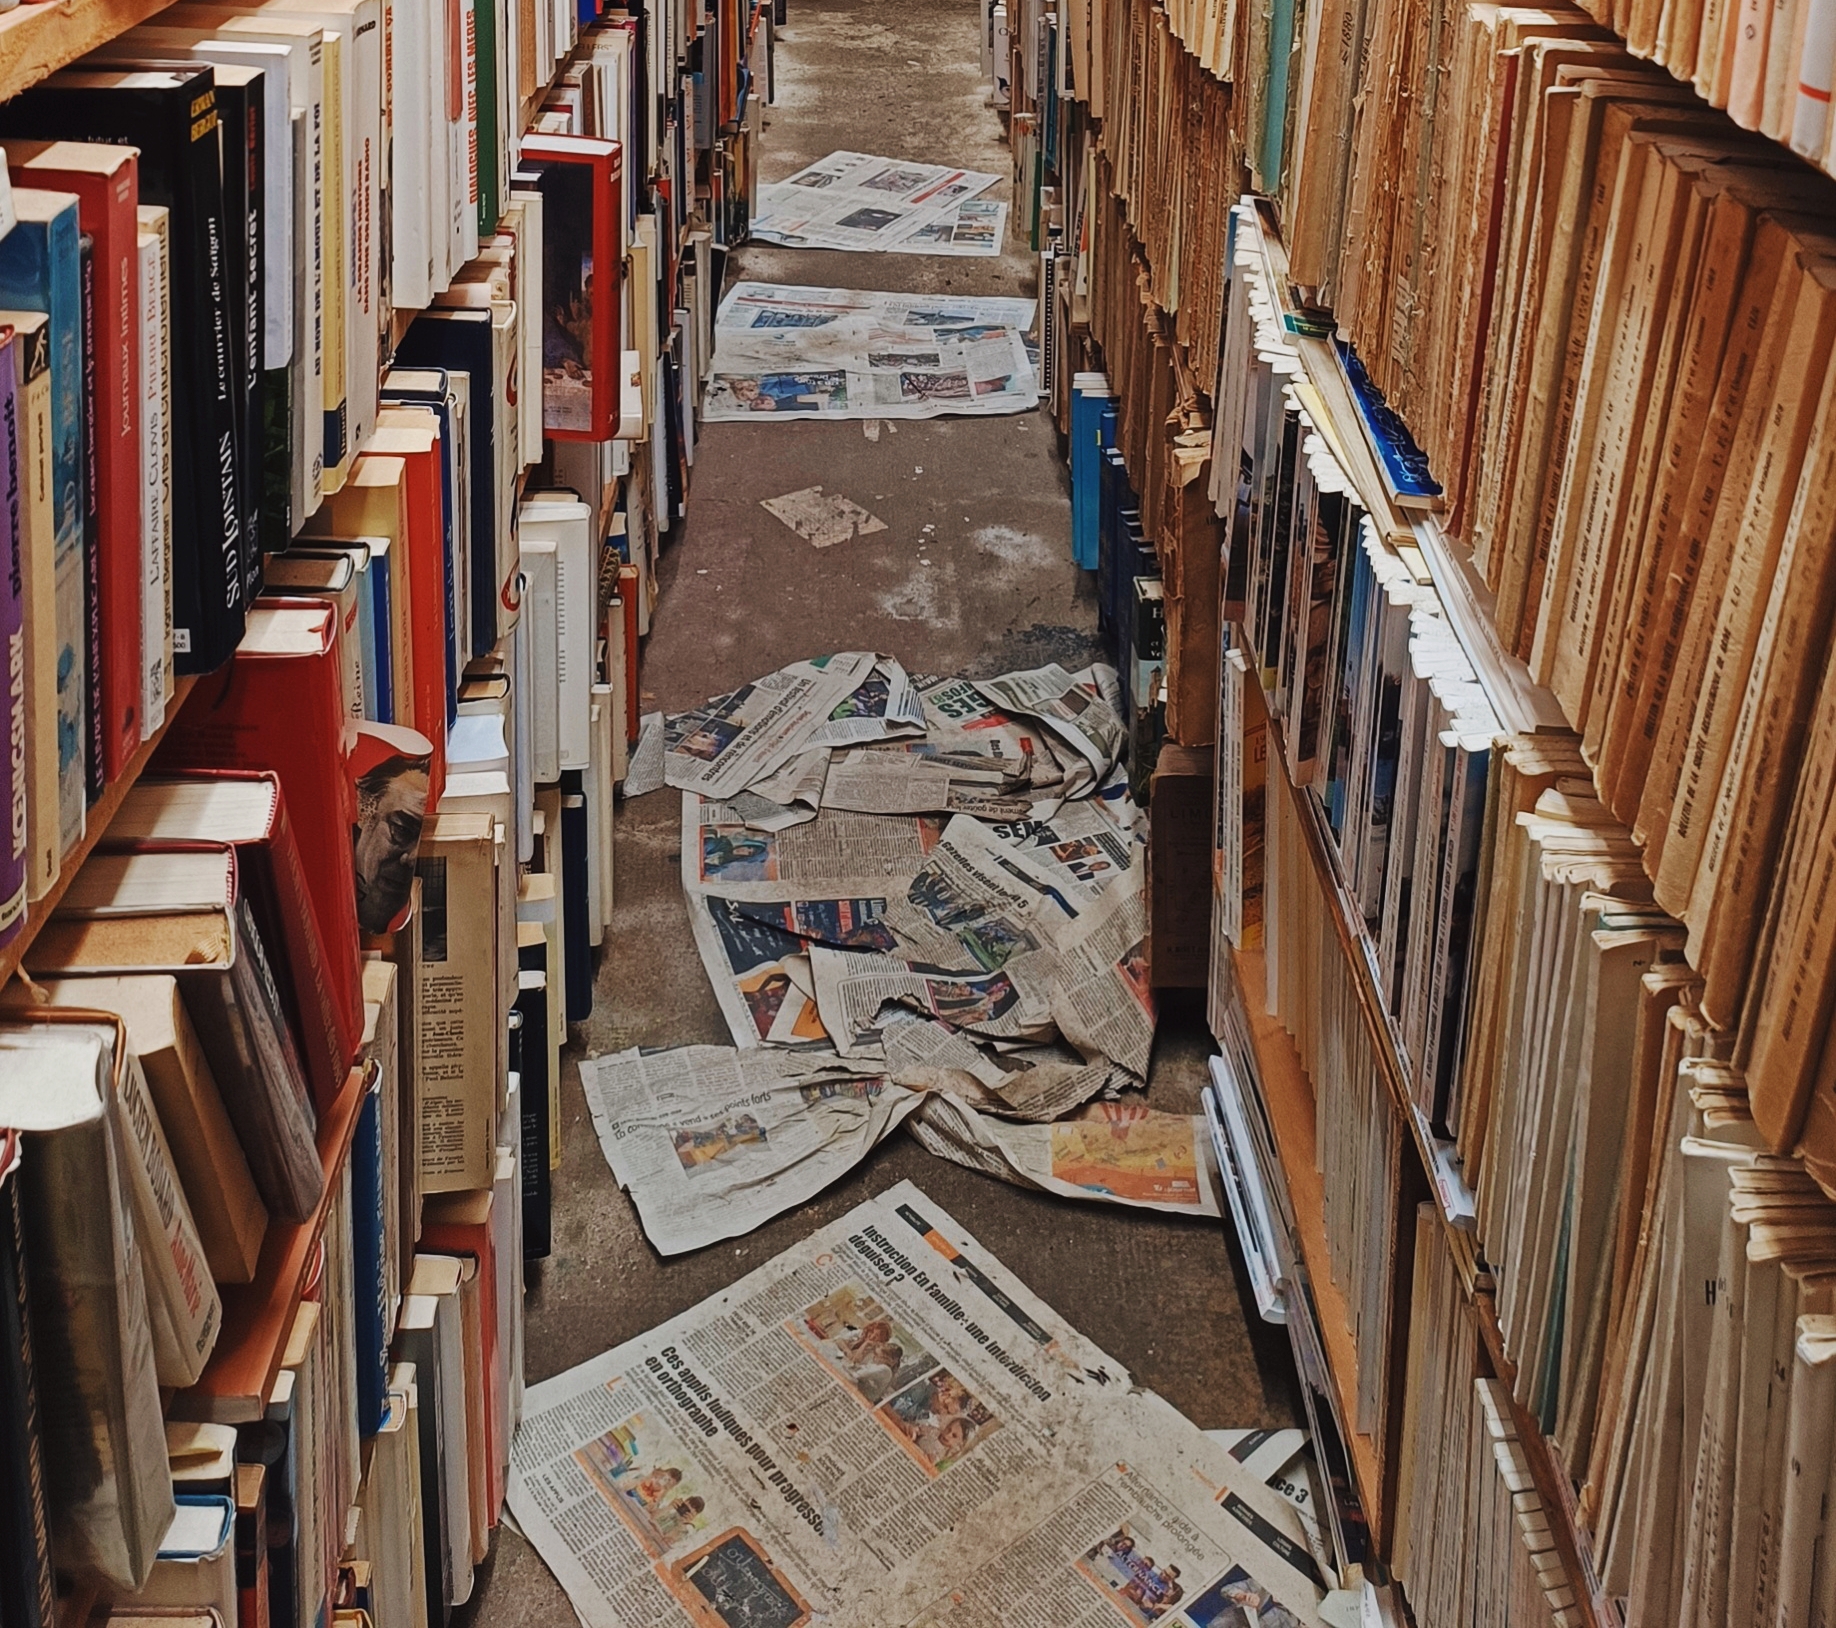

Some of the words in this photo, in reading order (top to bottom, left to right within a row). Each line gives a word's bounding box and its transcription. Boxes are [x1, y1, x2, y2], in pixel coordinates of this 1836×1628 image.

[467, 60, 477, 85] LES
[313, 102, 321, 129] FOI
[467, 89, 478, 123] AVEC
[313, 134, 321, 155] LA
[313, 164, 321, 185] DE
[363, 137, 371, 183] RADIO
[467, 128, 478, 205] DIALOGUES
[313, 191, 321, 212] ET
[363, 183, 371, 244] GRANDE
[247, 209, 258, 284] secret
[313, 215, 321, 285] L'AMOUR
[363, 244, 371, 273] UNE
[118, 256, 130, 339] intimes
[211, 282, 222, 302] de
[313, 287, 321, 309] DE
[363, 275, 371, 315] DANS
[144, 324, 157, 402] PIERRE
[213, 308, 227, 379] courrier
[247, 288, 259, 391] L'enfant
[313, 312, 321, 354] NOM
[118, 343, 132, 438] Journaux
[217, 382, 227, 402] Le
[313, 359, 321, 377] AU
[146, 412, 159, 487] CLOVIS
[218, 431, 240, 548] LOINTAIN
[8, 502, 22, 600] pierre
[146, 489, 160, 587] L'AFFAIRE
[224, 548, 241, 610] SUD
[9, 623, 28, 860] KŒNIGSMARK
[973, 868, 1000, 893] visent
[678, 1115, 703, 1130] vend
[723, 1097, 751, 1113] points
[750, 1091, 772, 1106] forts
[848, 1232, 894, 1280] déguisée
[861, 1224, 917, 1276] Instruction
[913, 1269, 929, 1286] En
[925, 1282, 963, 1322] Famille
[964, 1322, 988, 1345] une
[986, 1338, 1052, 1403] interdiction
[644, 1354, 660, 1371] en
[656, 1367, 719, 1439] orthographe
[660, 1344, 681, 1369] Ces
[677, 1366, 709, 1401] applis
[708, 1398, 753, 1447] ludiques
[746, 1438, 776, 1473] pour
[1115, 1476, 1165, 1526] l'embauche
[1161, 1521, 1206, 1562] prolongée
[1124, 1470, 1169, 1513] Alternance
[1171, 1512, 1194, 1537] aide
